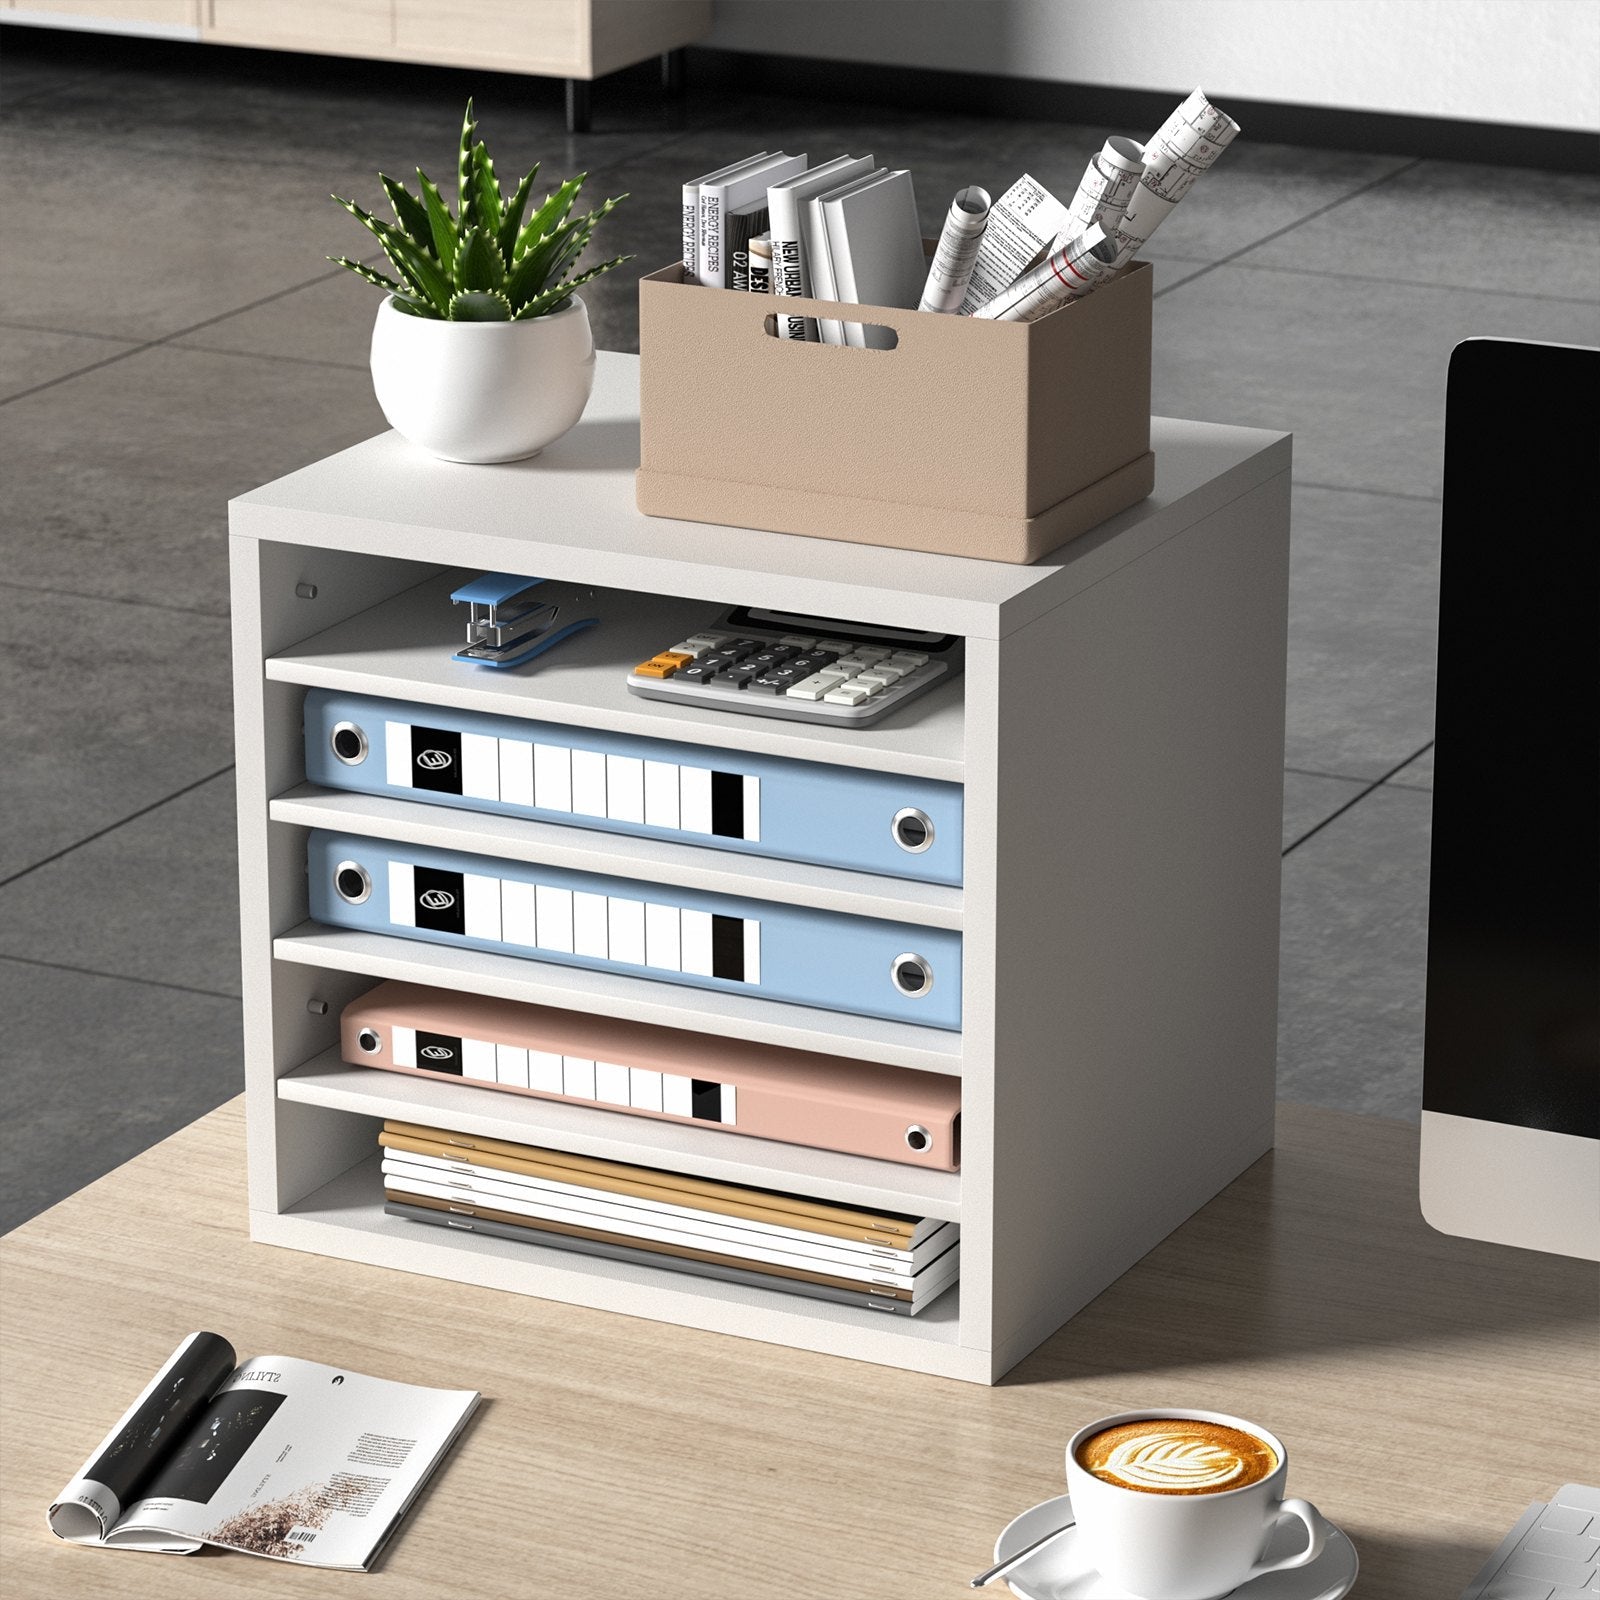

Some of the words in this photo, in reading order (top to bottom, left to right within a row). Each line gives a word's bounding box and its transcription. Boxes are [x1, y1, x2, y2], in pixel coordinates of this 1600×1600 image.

[683, 205, 695, 240] ENERGY
[708, 196, 719, 234] ENERGY
[683, 241, 695, 278] RECIPES
[708, 235, 719, 273] RECIPES
[771, 240, 782, 267] HILARY
[782, 240, 799, 264] NEW
[739, 663, 757, 671] 2
